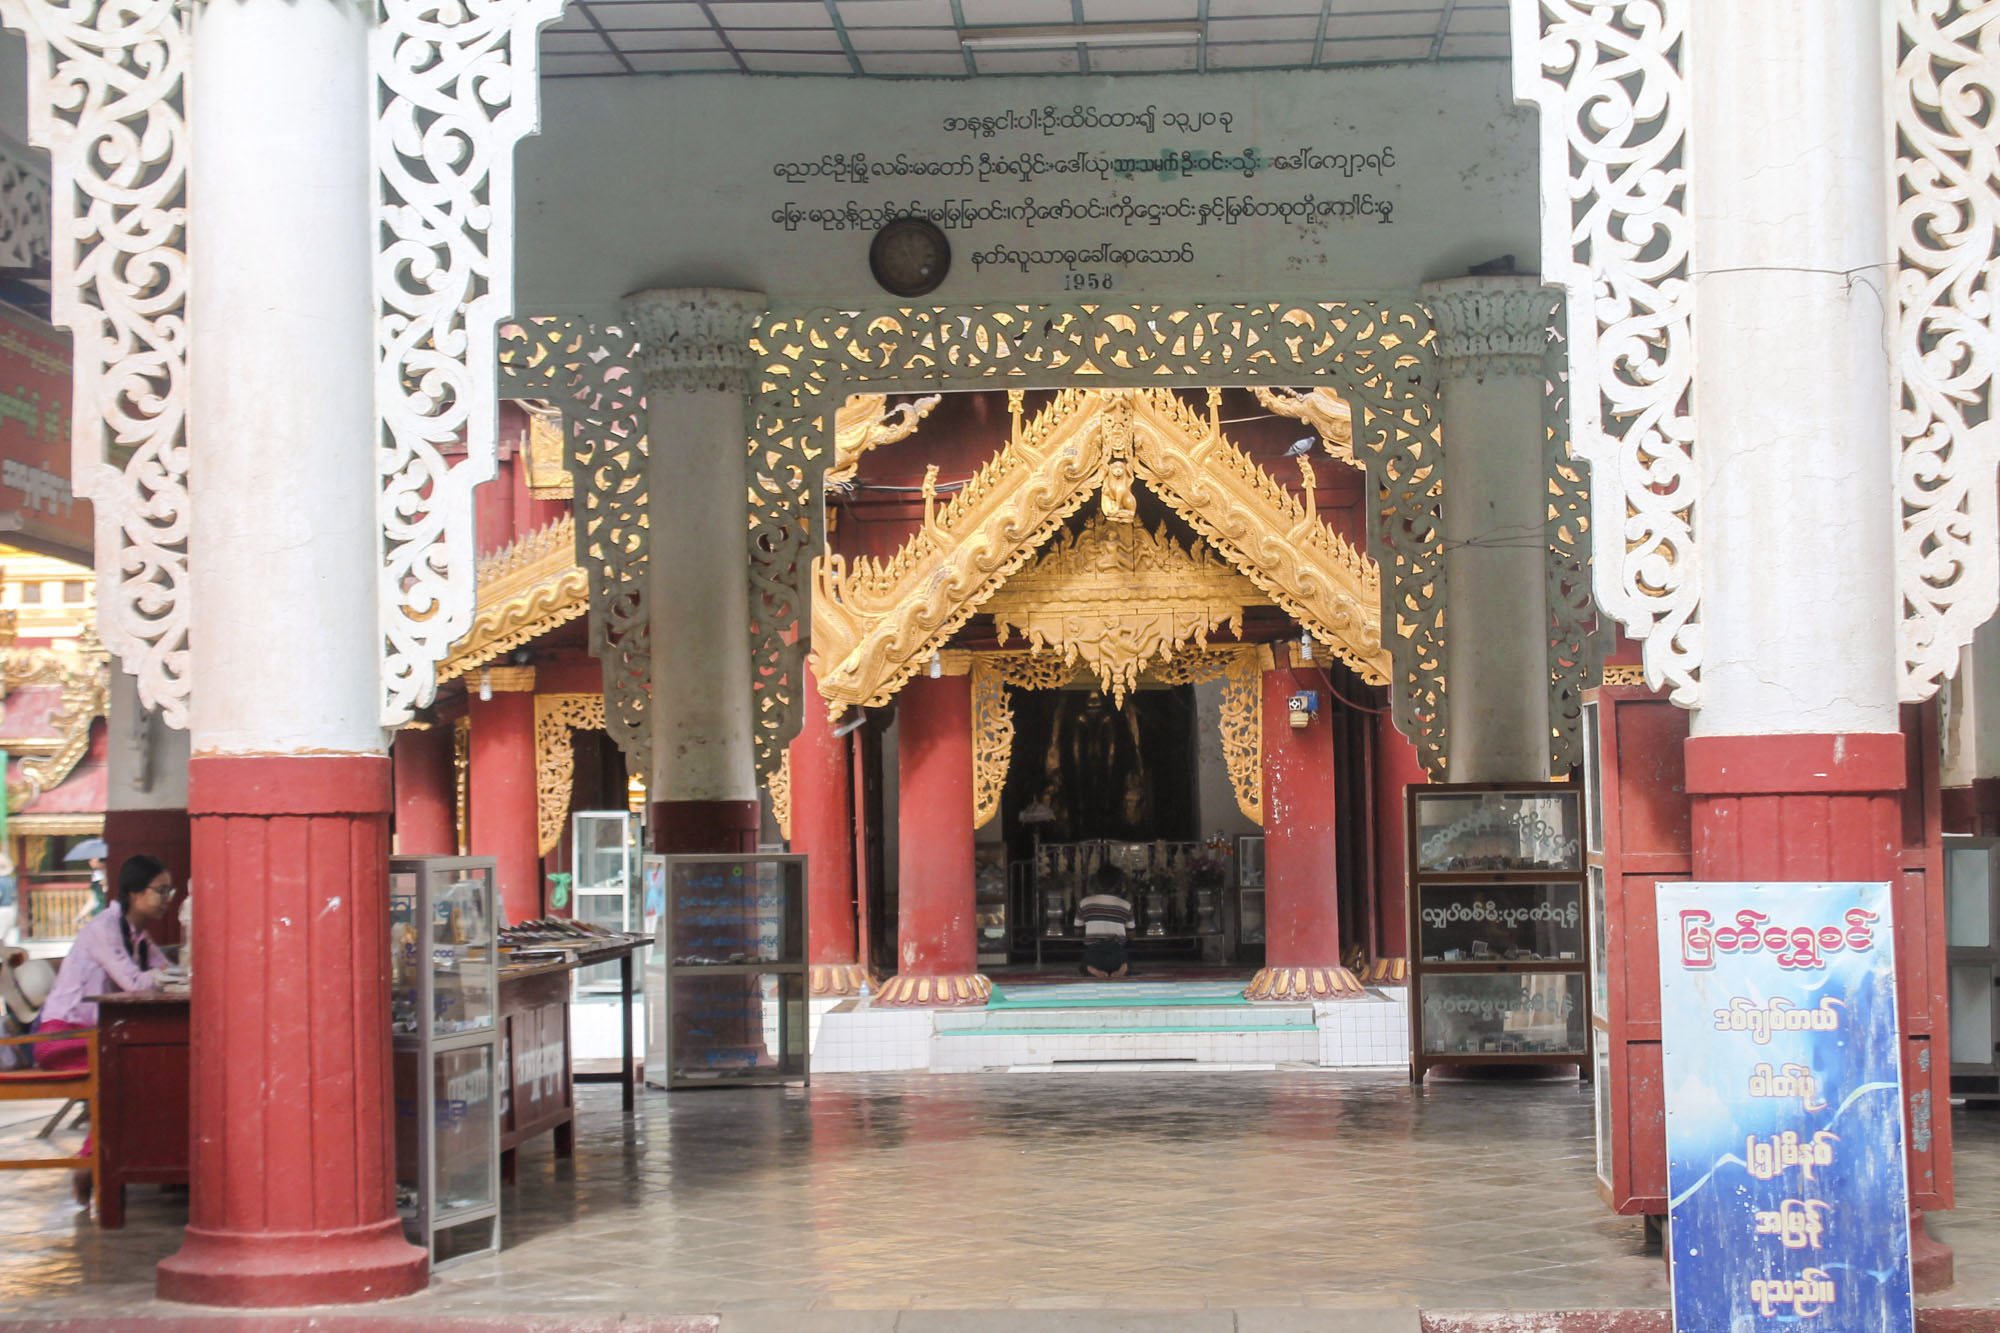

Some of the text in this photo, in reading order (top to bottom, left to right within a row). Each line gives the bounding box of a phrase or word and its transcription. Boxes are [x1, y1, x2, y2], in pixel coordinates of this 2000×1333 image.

[1679, 908, 1878, 968] မြတ်ရွှေစင်
[1714, 996, 1847, 1045] ဒစ်ဂျစ်တယ်
[1755, 1198, 1832, 1249] အမြန်
